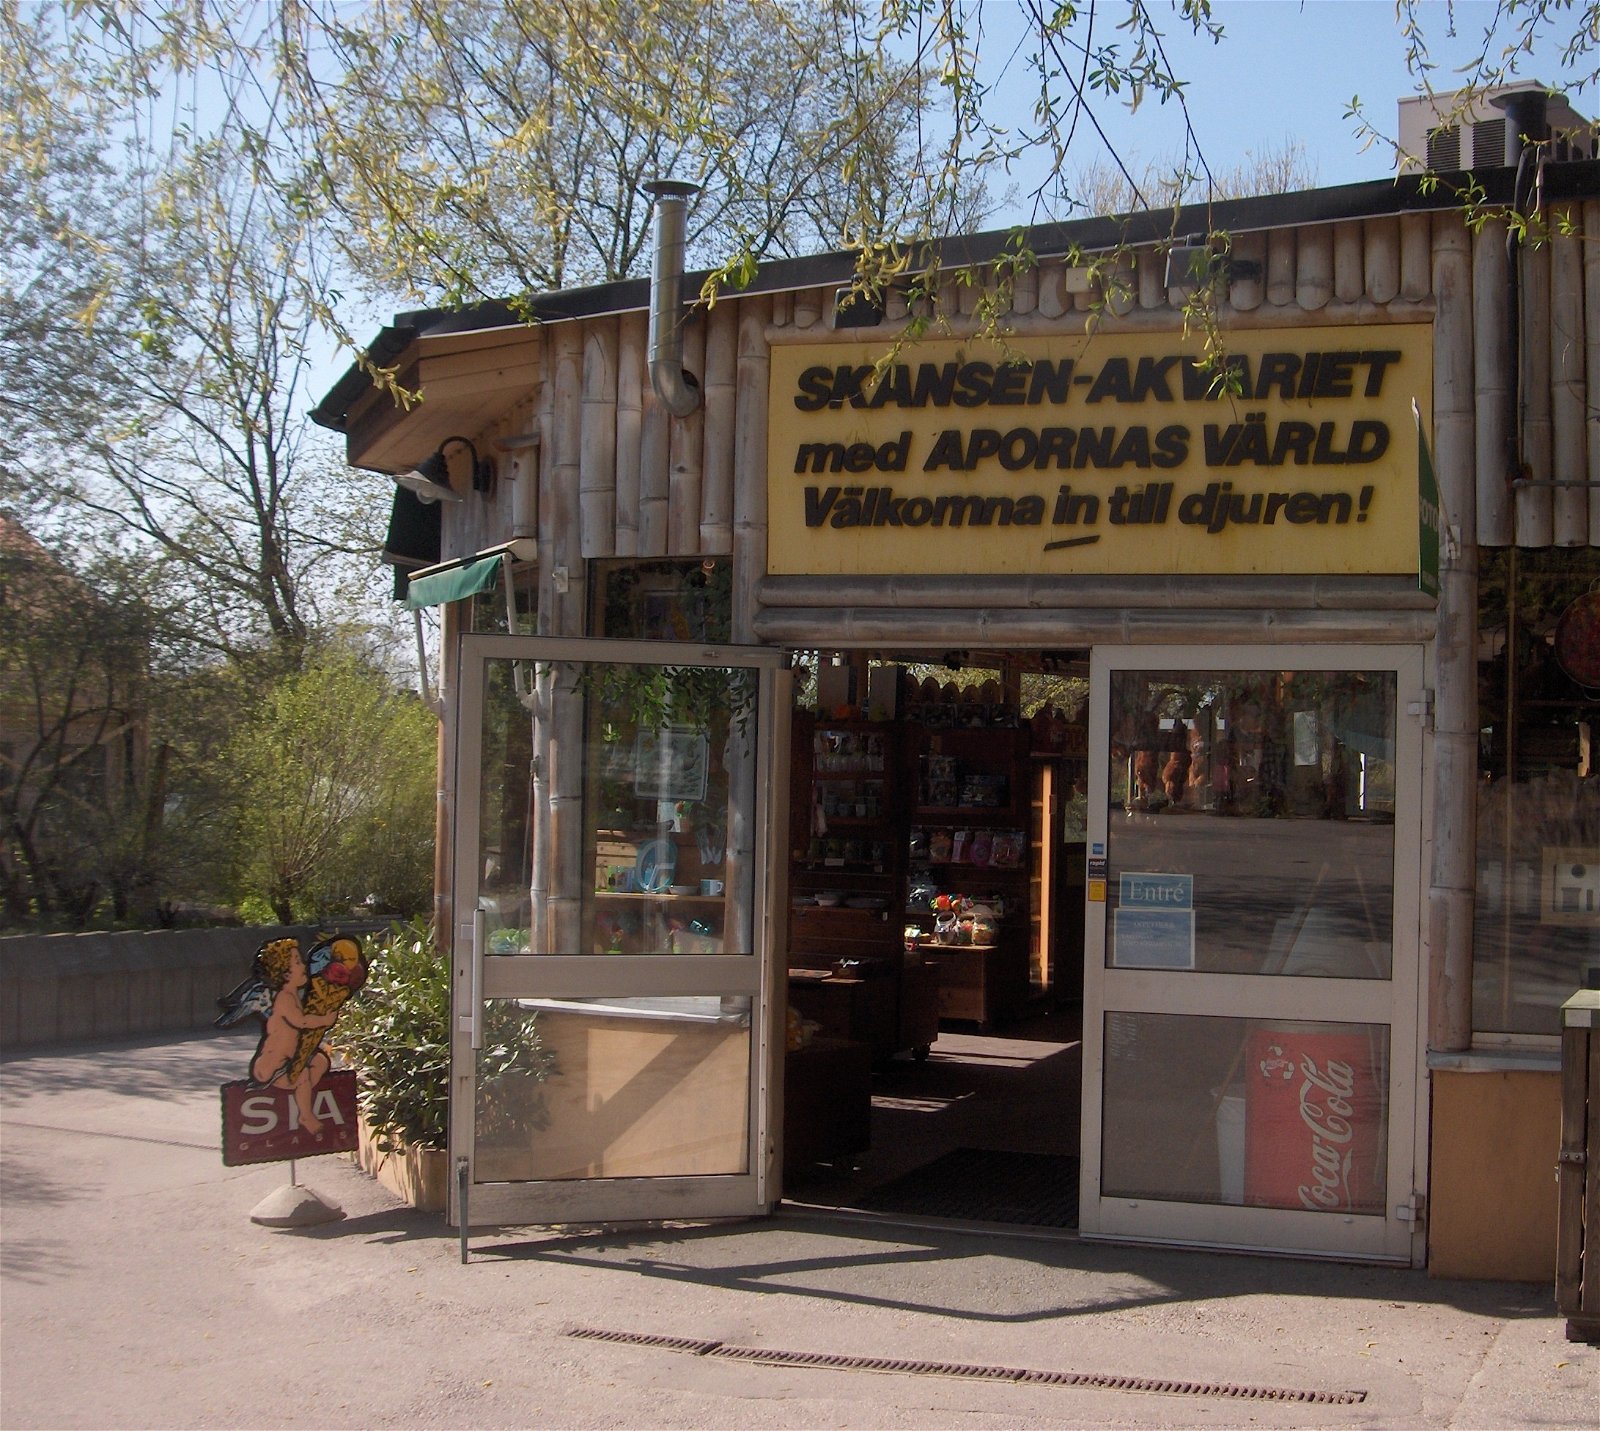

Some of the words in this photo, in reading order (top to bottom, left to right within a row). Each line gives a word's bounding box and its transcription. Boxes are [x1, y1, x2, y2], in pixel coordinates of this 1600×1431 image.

[794, 351, 1401, 410] SKANSEN-AKVARIET
[795, 431, 911, 473] med
[924, 428, 1189, 471] APORNAS
[1203, 413, 1390, 466] VÄRLD
[803, 487, 1044, 528] Välkomna
[1052, 484, 1100, 525] in
[1108, 483, 1174, 523] till
[1178, 483, 1374, 533] djuren!
[1130, 881, 1184, 902] Entré
[241, 1090, 344, 1134] SIA
[240, 1132, 346, 1151] GLASS
